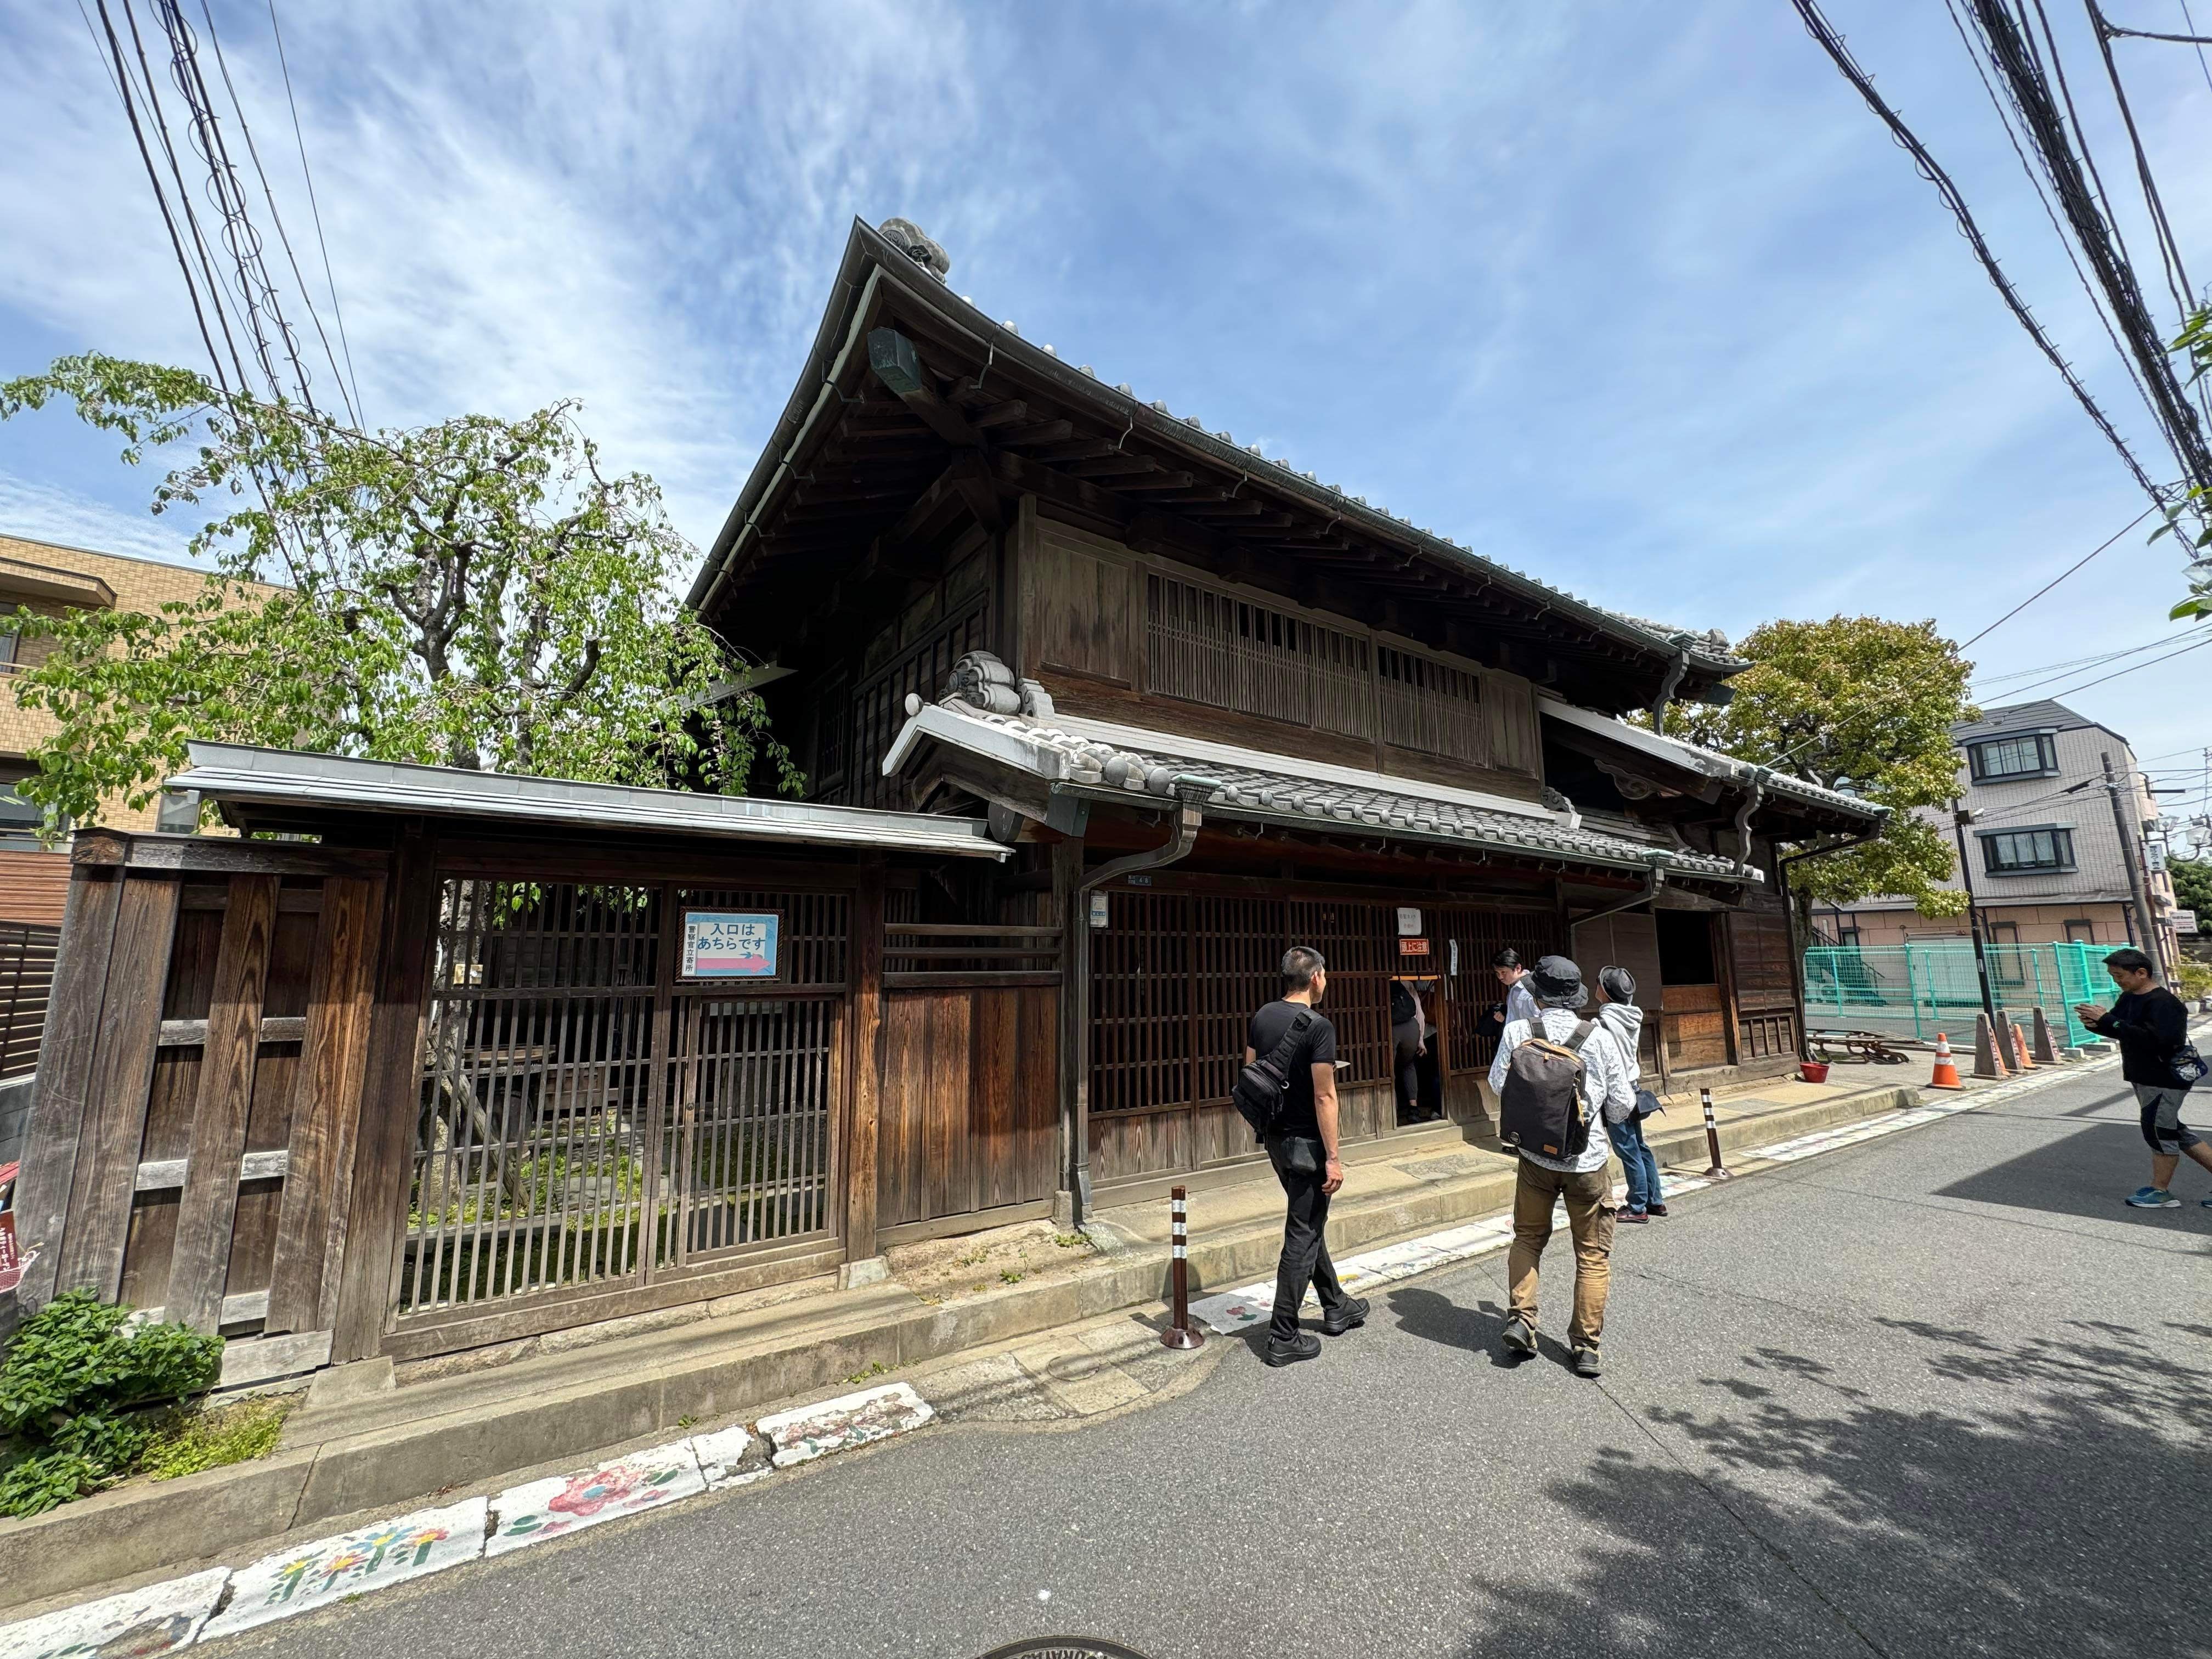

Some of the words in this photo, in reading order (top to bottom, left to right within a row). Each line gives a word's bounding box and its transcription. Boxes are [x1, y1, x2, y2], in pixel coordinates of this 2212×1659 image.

[710, 923, 755, 935] 入口は
[685, 926, 696, 972] 警察官立寄所
[697, 936, 766, 950] あちらです
